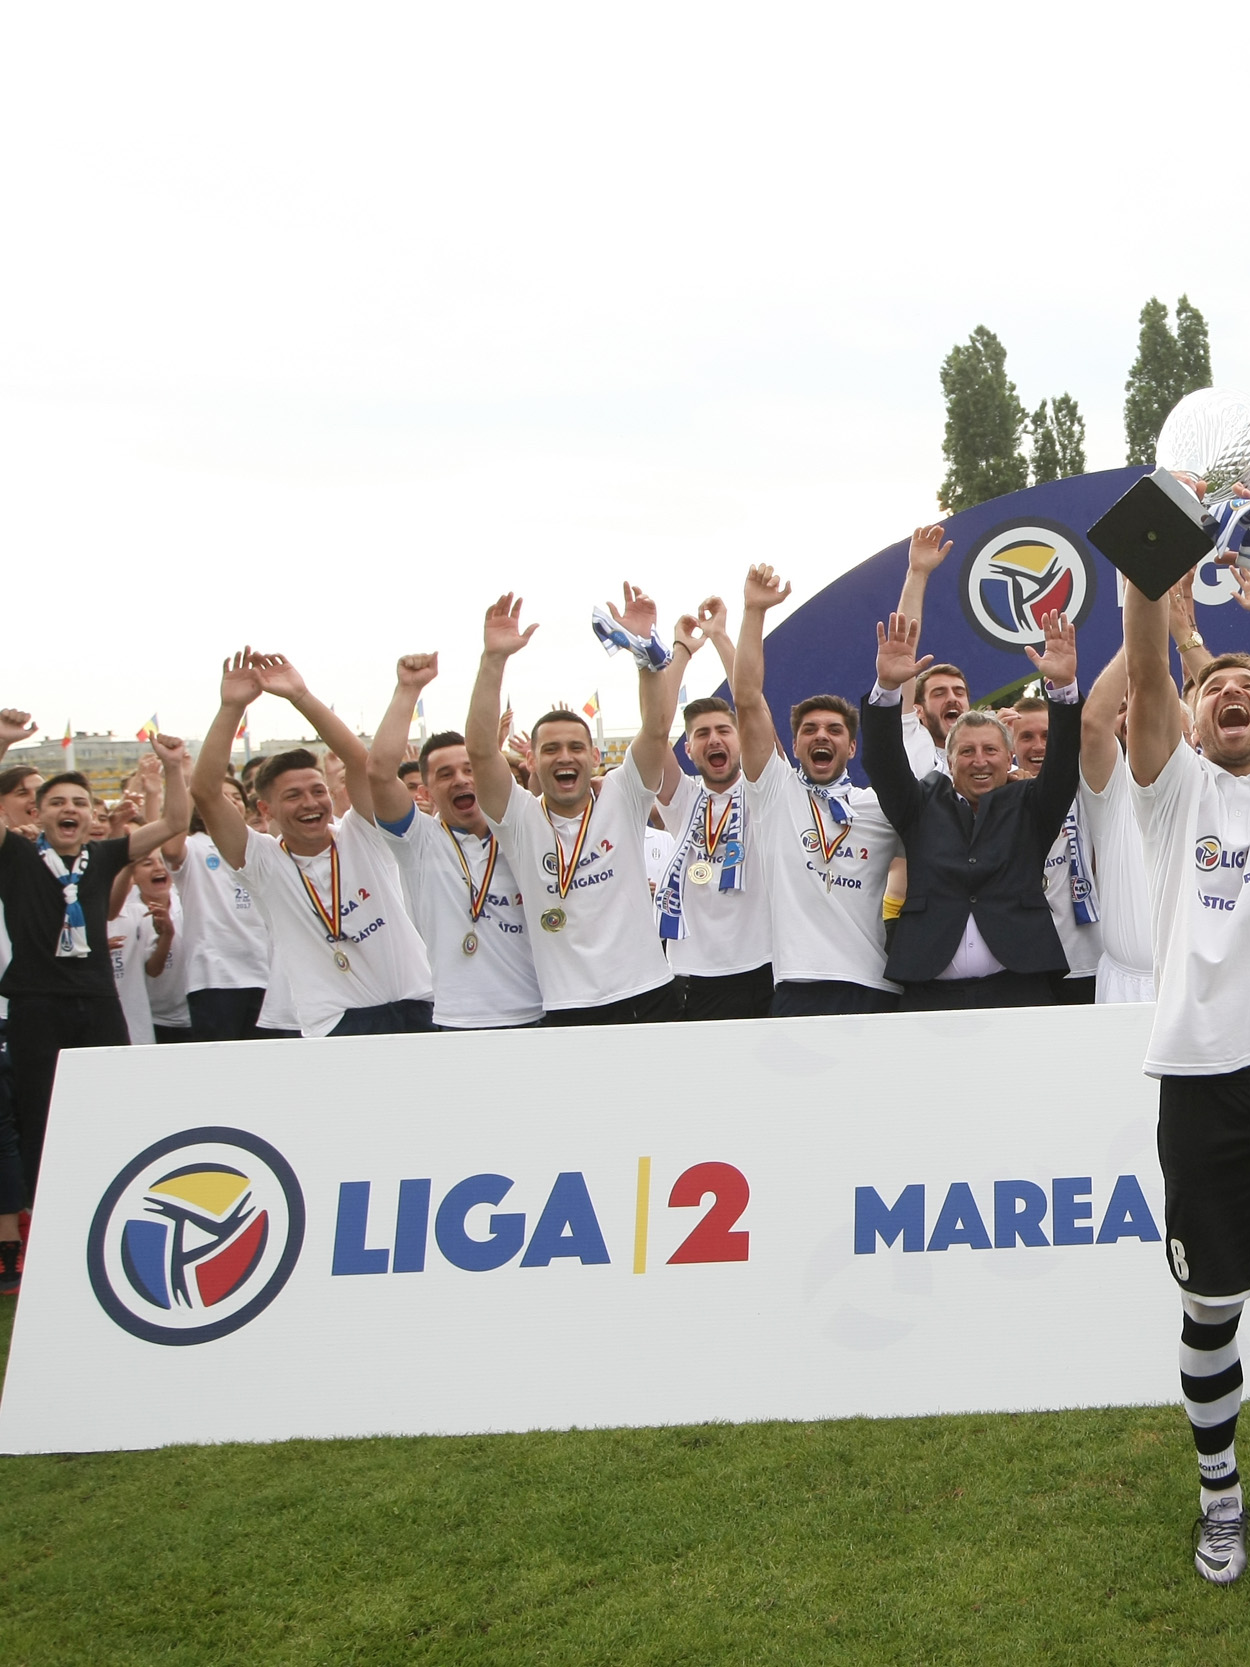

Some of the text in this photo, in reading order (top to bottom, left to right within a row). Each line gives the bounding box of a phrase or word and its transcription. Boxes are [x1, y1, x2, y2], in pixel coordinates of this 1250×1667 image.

[601, 839, 614, 852] 2
[860, 848, 868, 860] 2
[1221, 850, 1245, 868] LIG
[358, 888, 371, 901] 2
[331, 1161, 750, 1276] LIGA 2
[854, 1175, 1162, 1254] MAREA
[1170, 1238, 1190, 1282] 8
